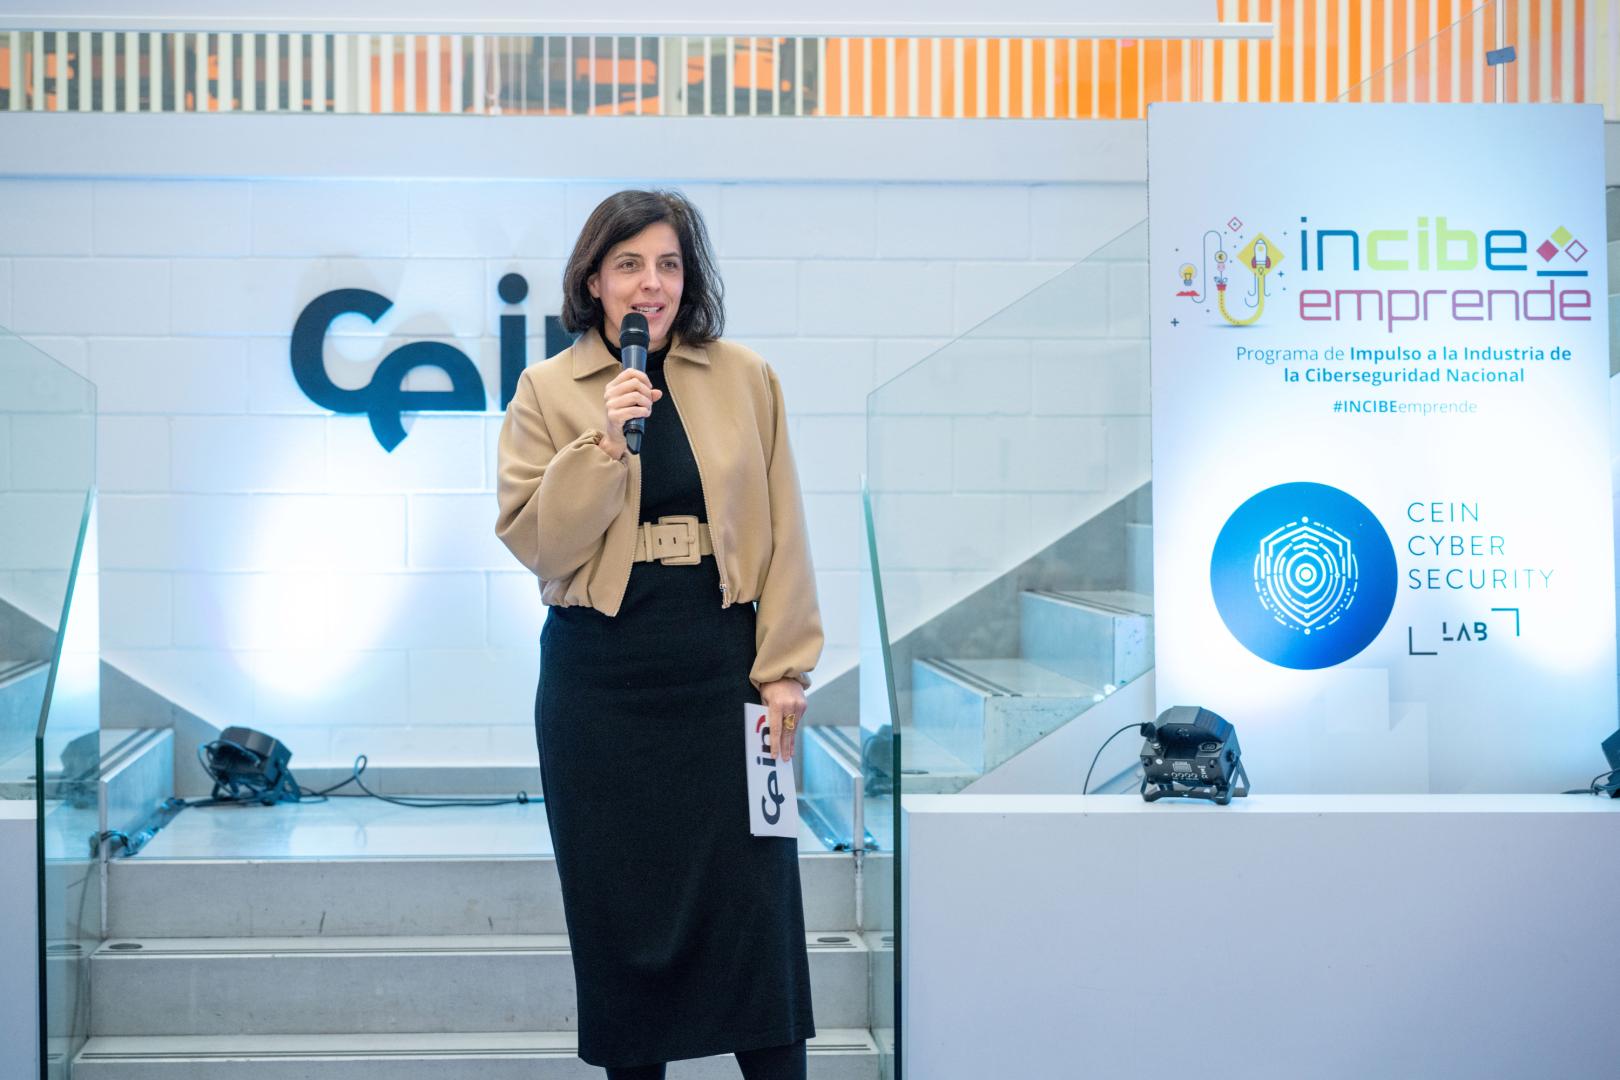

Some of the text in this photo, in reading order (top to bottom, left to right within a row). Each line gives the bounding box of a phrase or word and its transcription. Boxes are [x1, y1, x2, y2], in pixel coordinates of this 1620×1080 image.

[1300, 216, 1528, 271] incibe
[1299, 279, 1591, 333] emprende
[1236, 346, 1572, 365] Programa de Impulso a la Industria de
[1284, 368, 1525, 387] la Ciberseguridad Nacional
[1333, 400, 1478, 417] #INCIBEemprende
[1407, 502, 1479, 523] CEIN
[1408, 535, 1505, 557] CYBER
[1408, 568, 1555, 590] SECURITY
[1442, 621, 1488, 642] LAB
